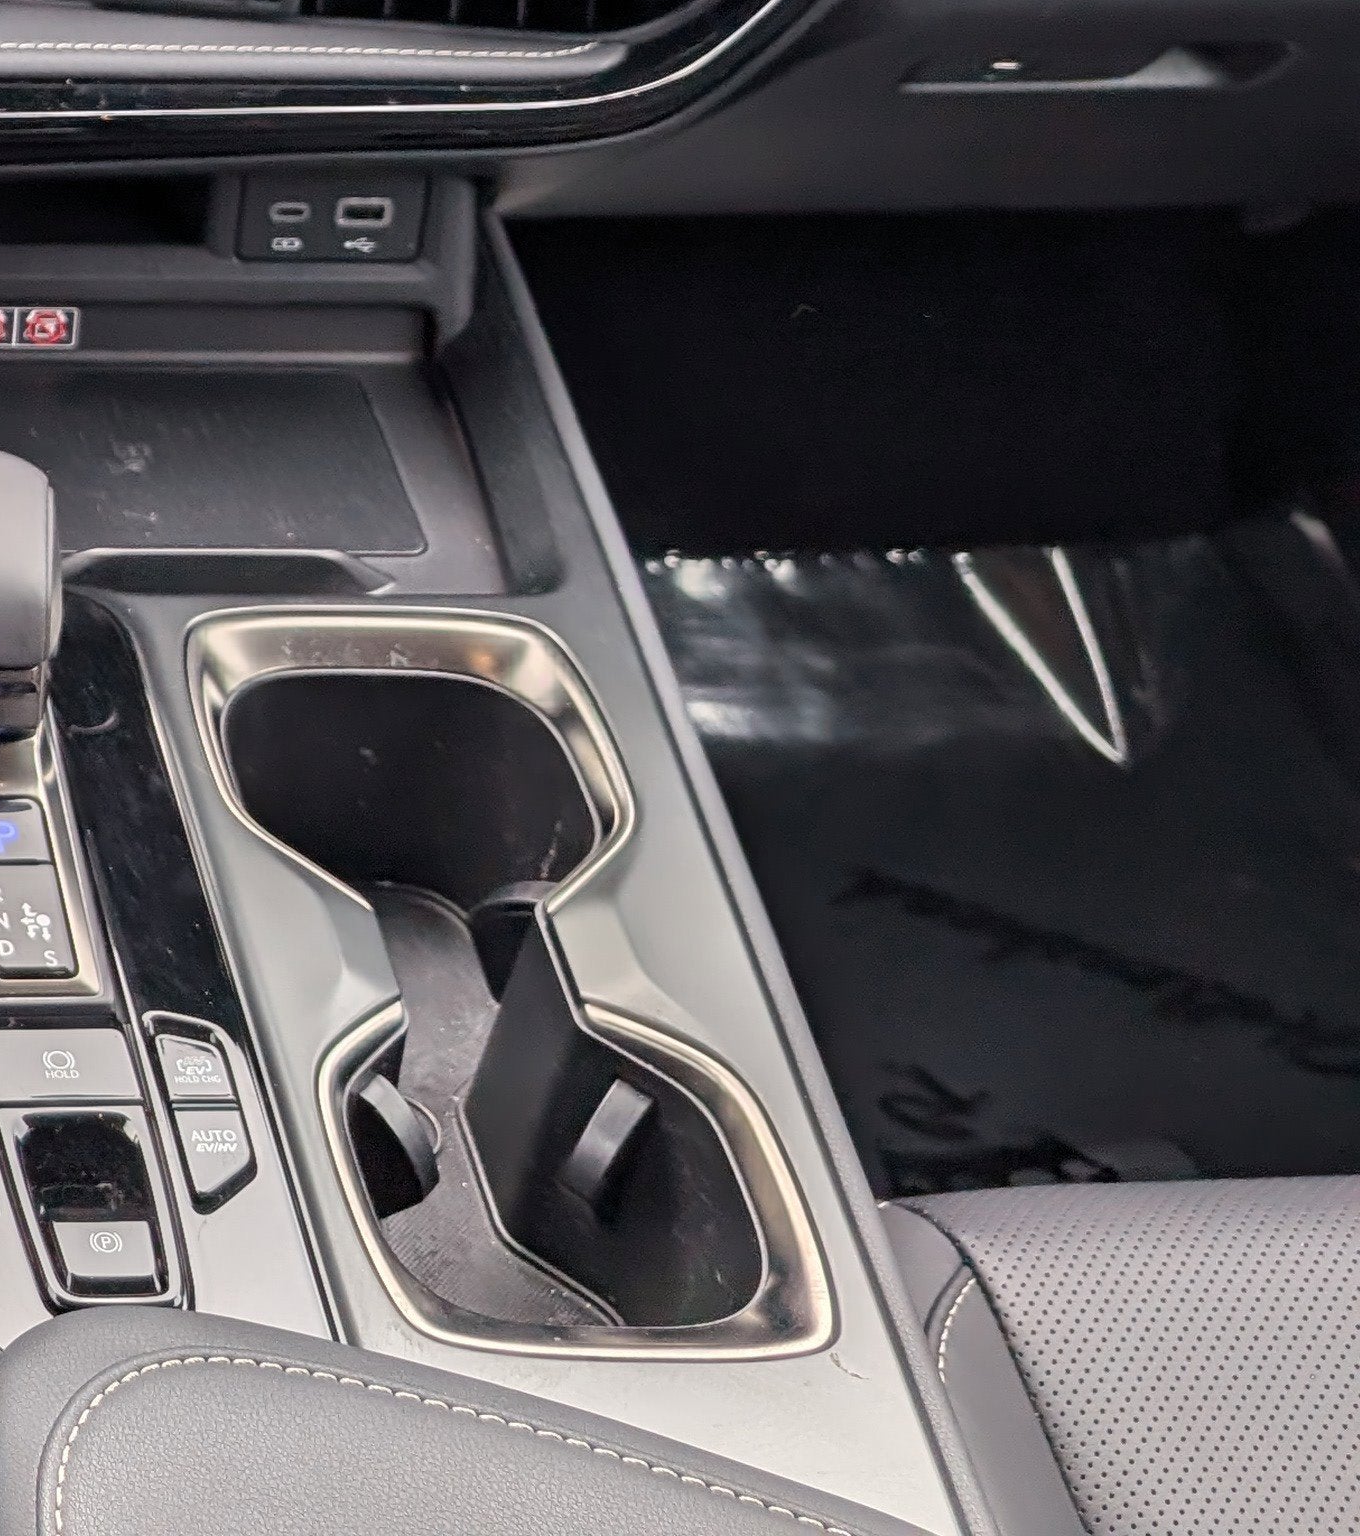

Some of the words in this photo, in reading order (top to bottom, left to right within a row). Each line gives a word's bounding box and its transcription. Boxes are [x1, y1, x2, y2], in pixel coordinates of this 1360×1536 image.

[44, 950, 58, 967] S
[44, 1069, 80, 1080] HOLD
[174, 1075, 199, 1083] HOLD
[191, 1129, 237, 1142] AUTO
[196, 1143, 239, 1154] EV/HV
